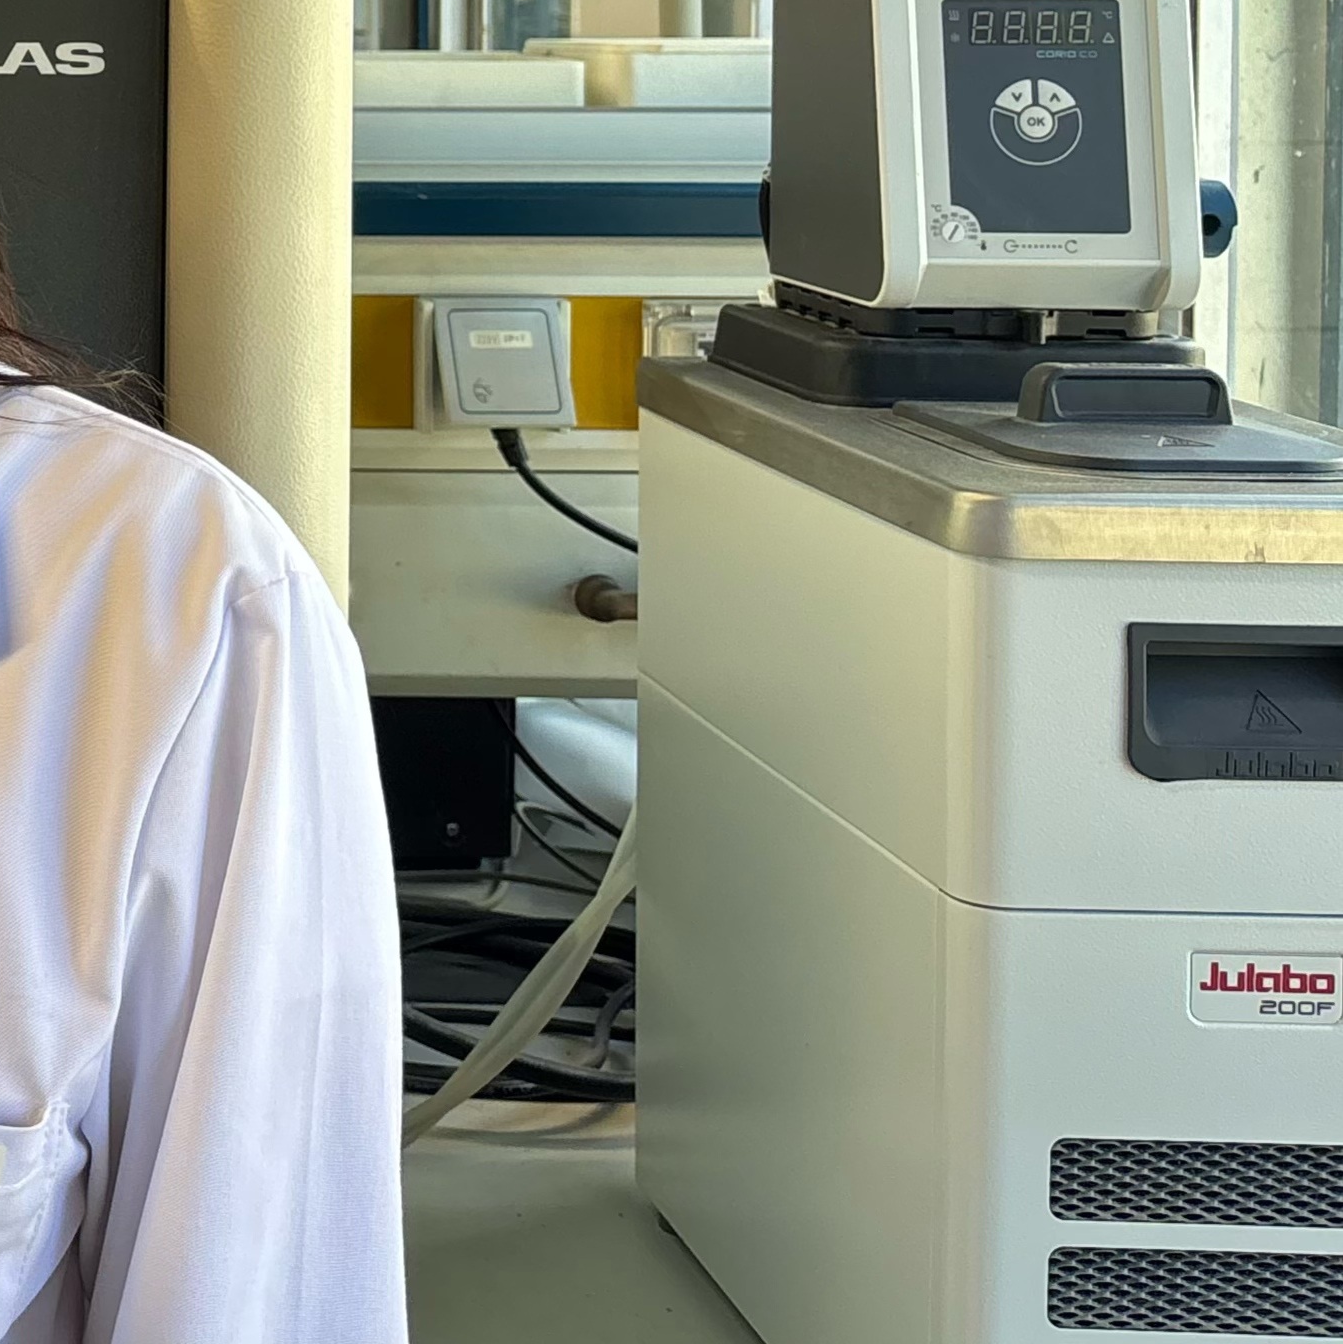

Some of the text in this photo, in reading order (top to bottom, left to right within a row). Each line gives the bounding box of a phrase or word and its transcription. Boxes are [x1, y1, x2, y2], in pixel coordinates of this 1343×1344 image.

[1026, 115, 1046, 128] OK
[1199, 961, 1336, 995] Julabo
[1258, 999, 1336, 1016] 200F
